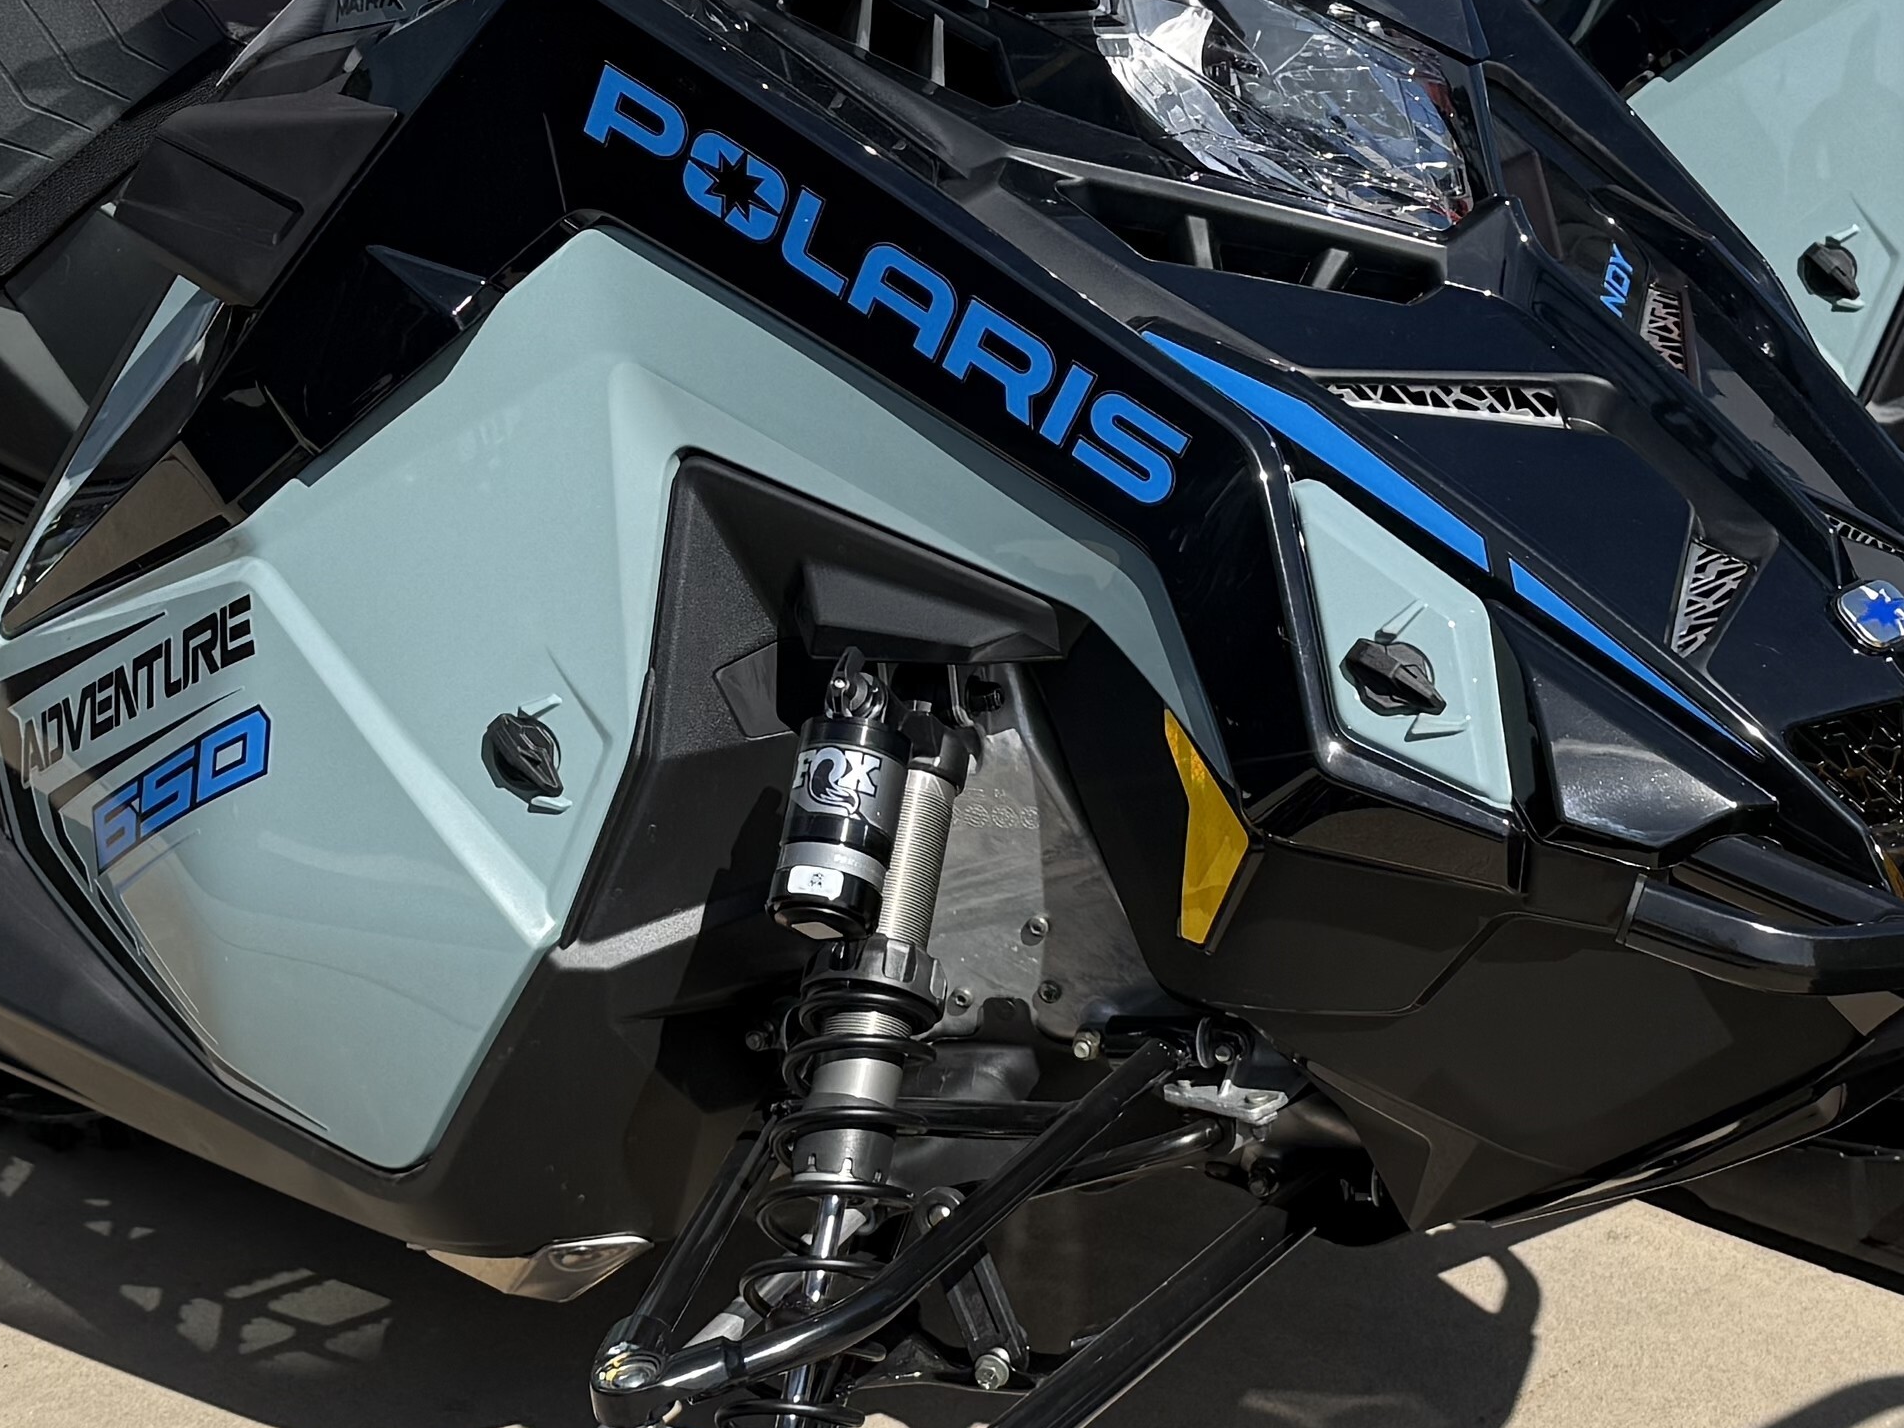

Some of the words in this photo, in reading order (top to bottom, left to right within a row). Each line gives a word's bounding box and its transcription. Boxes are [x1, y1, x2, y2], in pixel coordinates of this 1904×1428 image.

[581, 59, 1192, 506] POLARIS
[1599, 242, 1634, 319] NDY
[20, 593, 257, 787] ADVENTURE
[92, 703, 272, 876] 650
[791, 746, 883, 815] FOX
